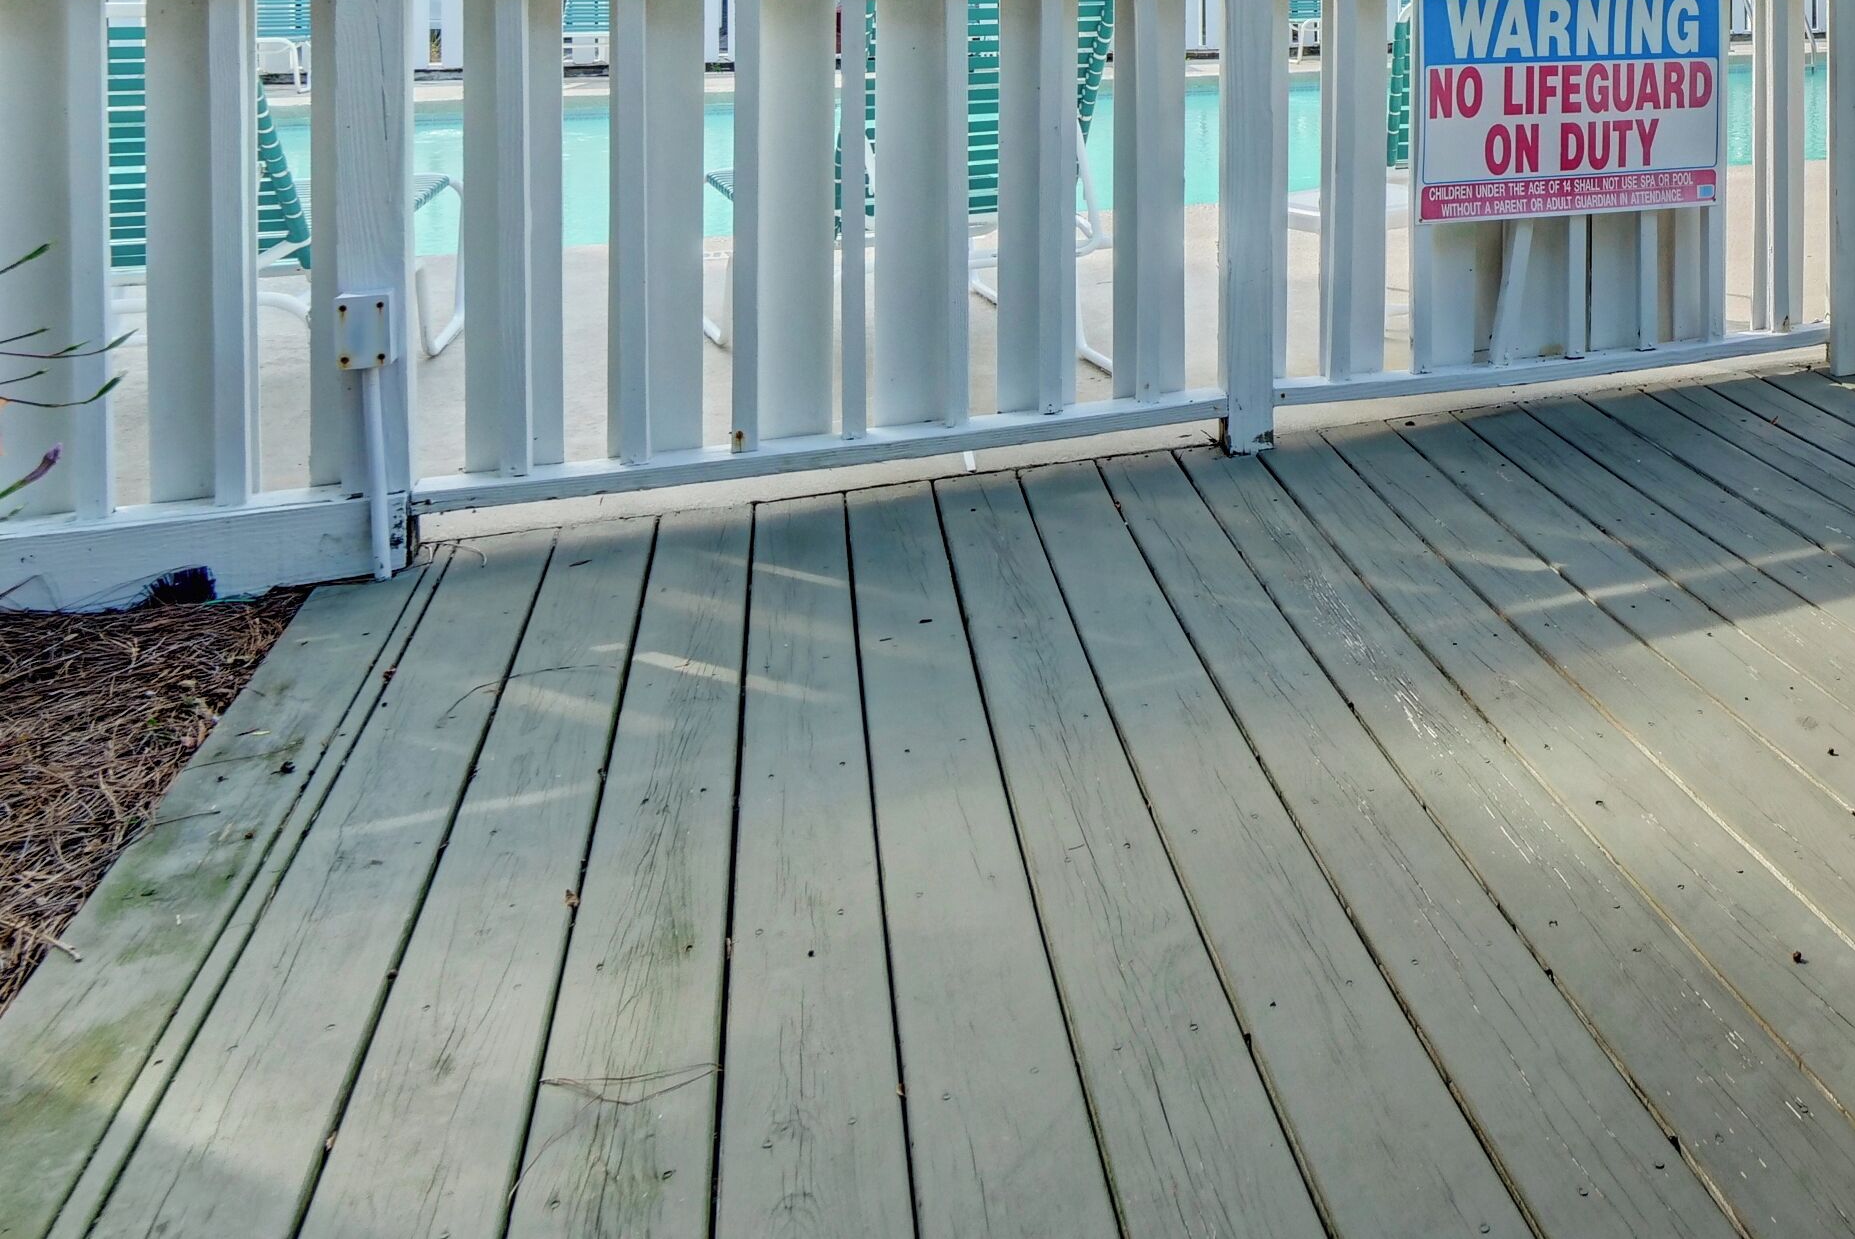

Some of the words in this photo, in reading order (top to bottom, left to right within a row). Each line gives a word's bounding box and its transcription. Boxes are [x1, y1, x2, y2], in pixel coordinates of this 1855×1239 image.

[1429, 66, 1483, 120] NO
[1503, 60, 1713, 116] LIFEGUARD
[1484, 123, 1540, 176] ON
[1560, 118, 1660, 171] DUTY
[1429, 187, 1473, 201] CHILDREN
[1475, 185, 1506, 198] UNDER
[1508, 184, 1526, 196] THE
[1528, 183, 1546, 194] AGE
[1548, 182, 1561, 193] OF
[1562, 181, 1571, 193] 14
[1574, 179, 1600, 192] SHALL
[1602, 178, 1619, 190] NOT
[1621, 176, 1638, 189] USE
[1640, 175, 1656, 187] SPA
[1658, 174, 1670, 186] OR
[1672, 172, 1694, 186] POOL
[1441, 202, 1482, 217] WITHOUT
[1484, 202, 1491, 213] A
[1494, 200, 1528, 213] PARENT
[1530, 198, 1544, 210] OR
[1546, 196, 1572, 209] ADULT
[1575, 194, 1617, 208] GUARDIAN
[1619, 192, 1628, 205] IN
